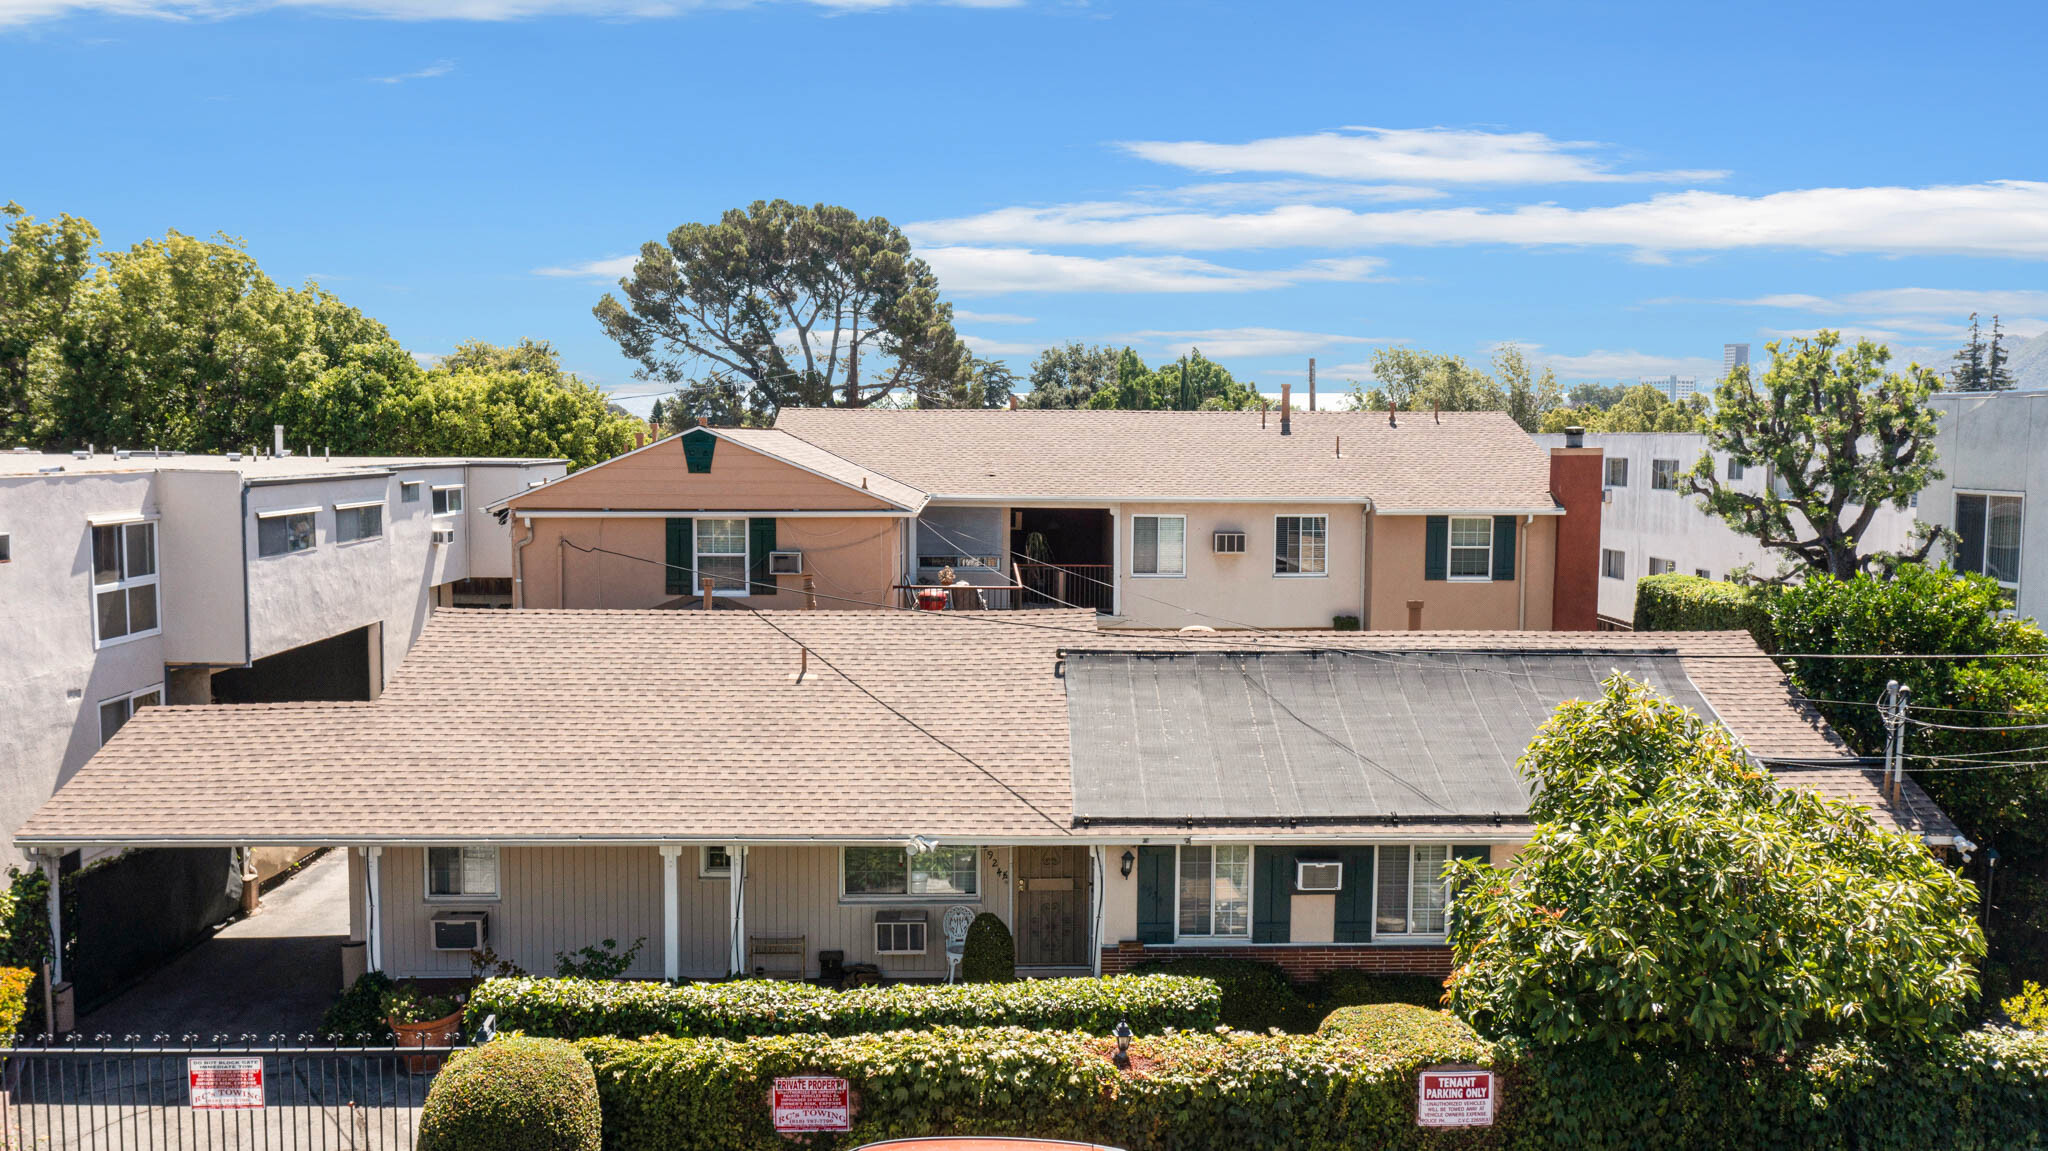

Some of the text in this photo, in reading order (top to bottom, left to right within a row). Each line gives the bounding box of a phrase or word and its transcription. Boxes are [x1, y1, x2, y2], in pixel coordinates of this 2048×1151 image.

[777, 1080, 845, 1089] PRIVATE PROPERTY
[1438, 1077, 1477, 1088] TENANT
[217, 1089, 262, 1102] TOWING
[1426, 1087, 1487, 1099] PARKING ONLY
[803, 1109, 846, 1122] TOWING
